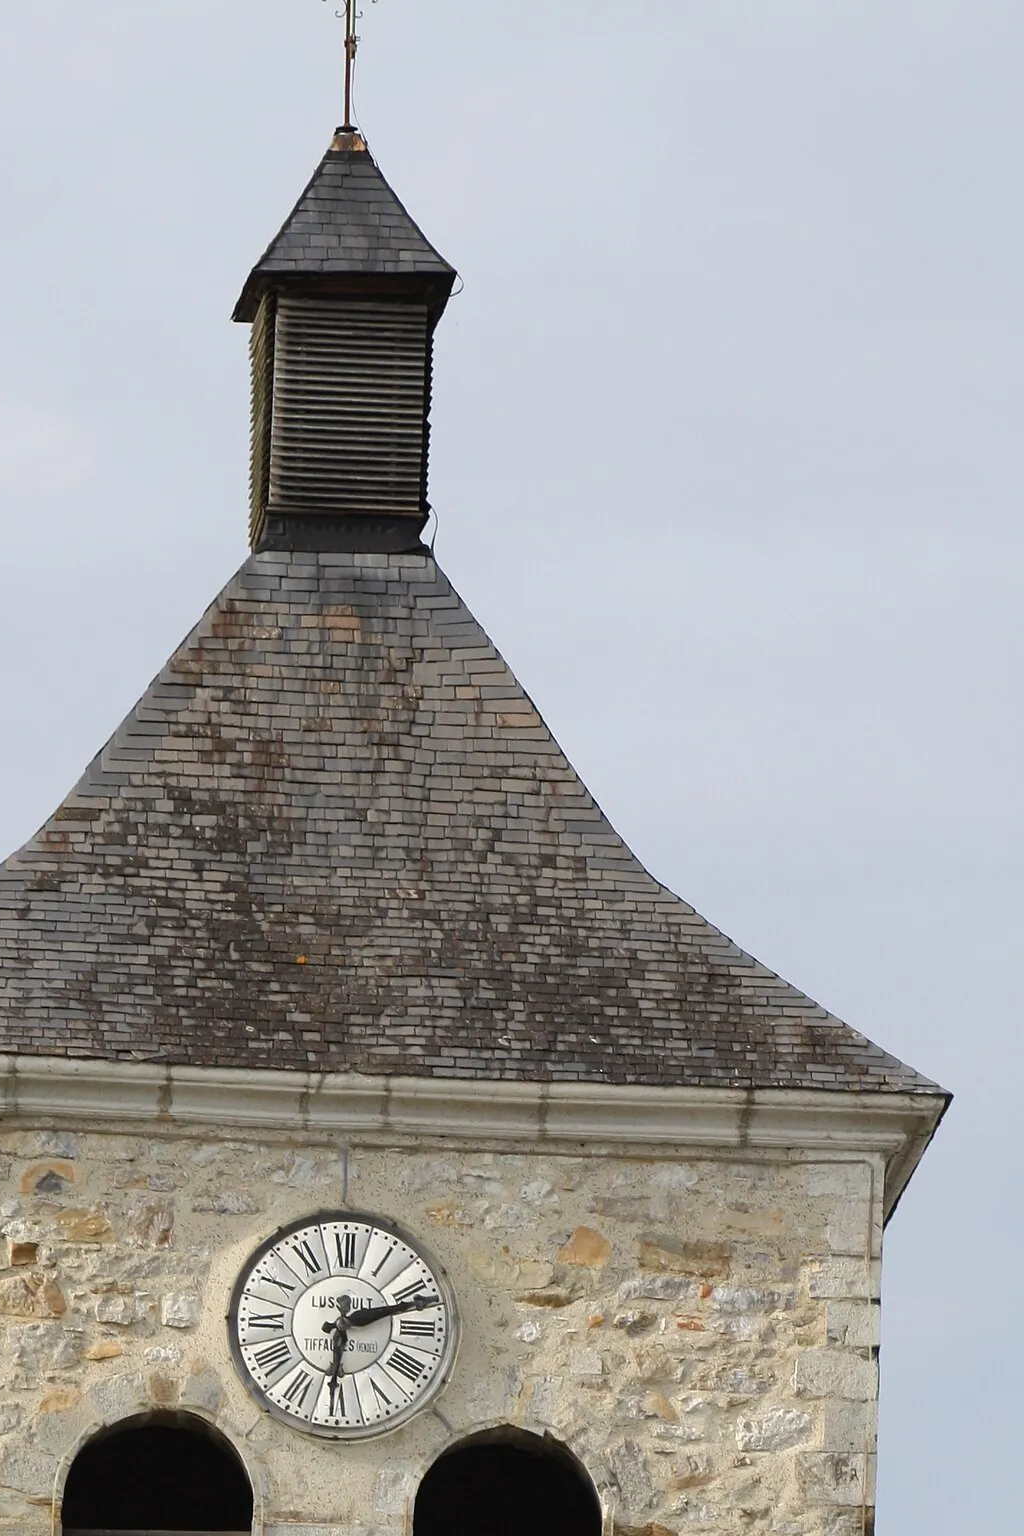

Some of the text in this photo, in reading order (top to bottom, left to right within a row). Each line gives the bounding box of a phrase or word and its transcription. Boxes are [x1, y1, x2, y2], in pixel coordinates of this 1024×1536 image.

[292, 1240, 323, 1277] XI
[333, 1233, 357, 1269] XII
[371, 1246, 394, 1278] I
[259, 1270, 296, 1299] X
[391, 1278, 427, 1303] II
[248, 1311, 285, 1331] IX
[399, 1319, 436, 1337] III
[254, 1340, 293, 1378] VIII
[387, 1347, 426, 1382] IIII
[281, 1369, 313, 1408] VII
[369, 1376, 392, 1410] V
